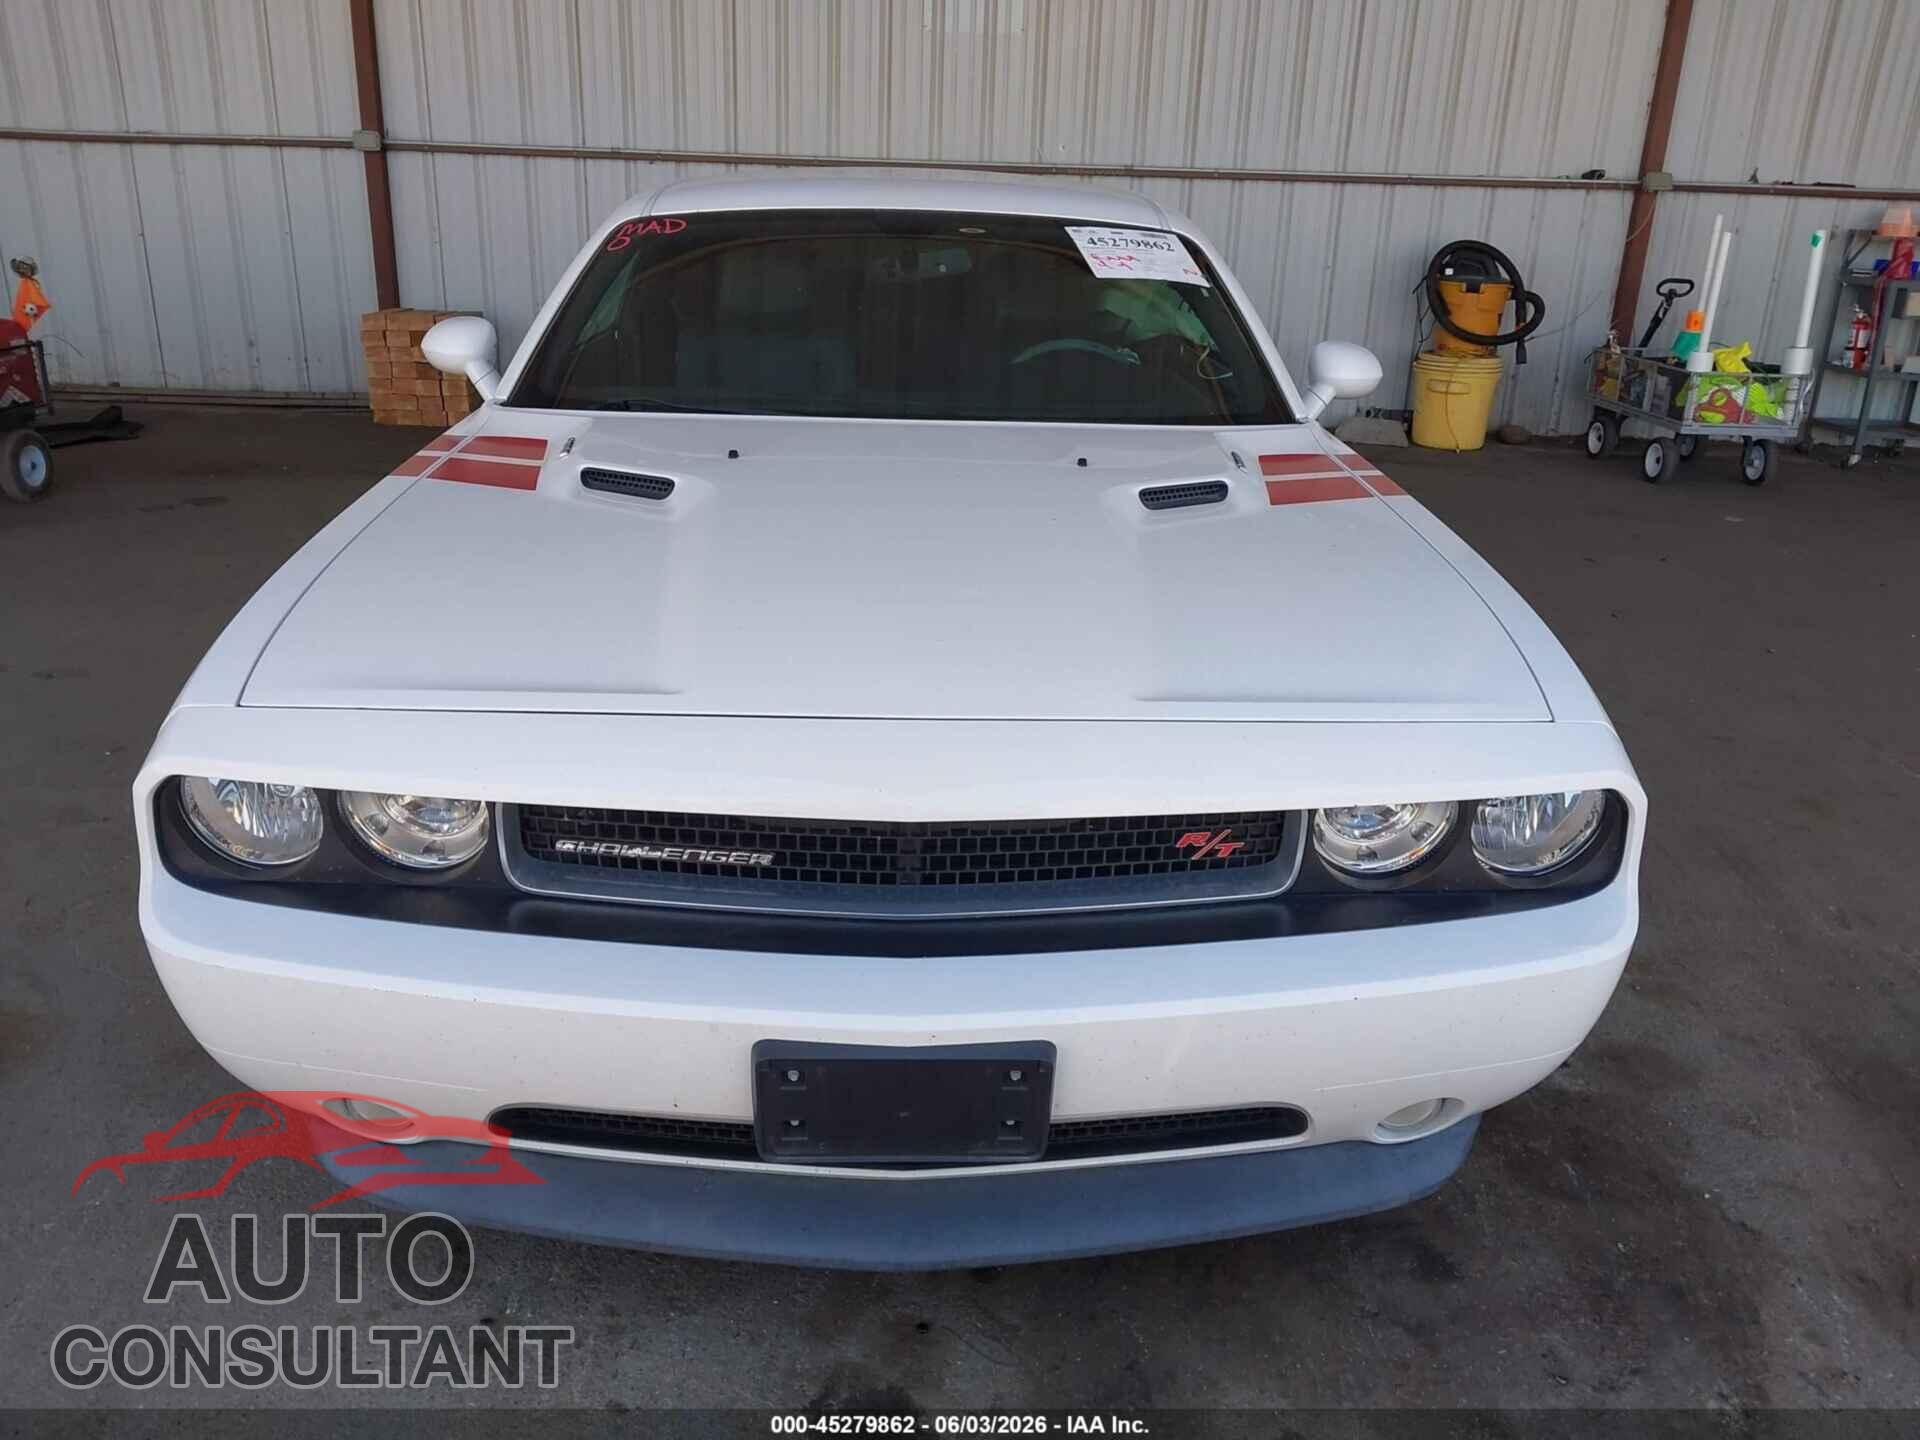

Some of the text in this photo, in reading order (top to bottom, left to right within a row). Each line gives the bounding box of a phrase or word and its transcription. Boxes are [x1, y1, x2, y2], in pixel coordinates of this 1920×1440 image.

[1087, 236, 1175, 252] 45279862
[555, 839, 776, 866] CHALLENGER
[1175, 828, 1246, 860] R/T
